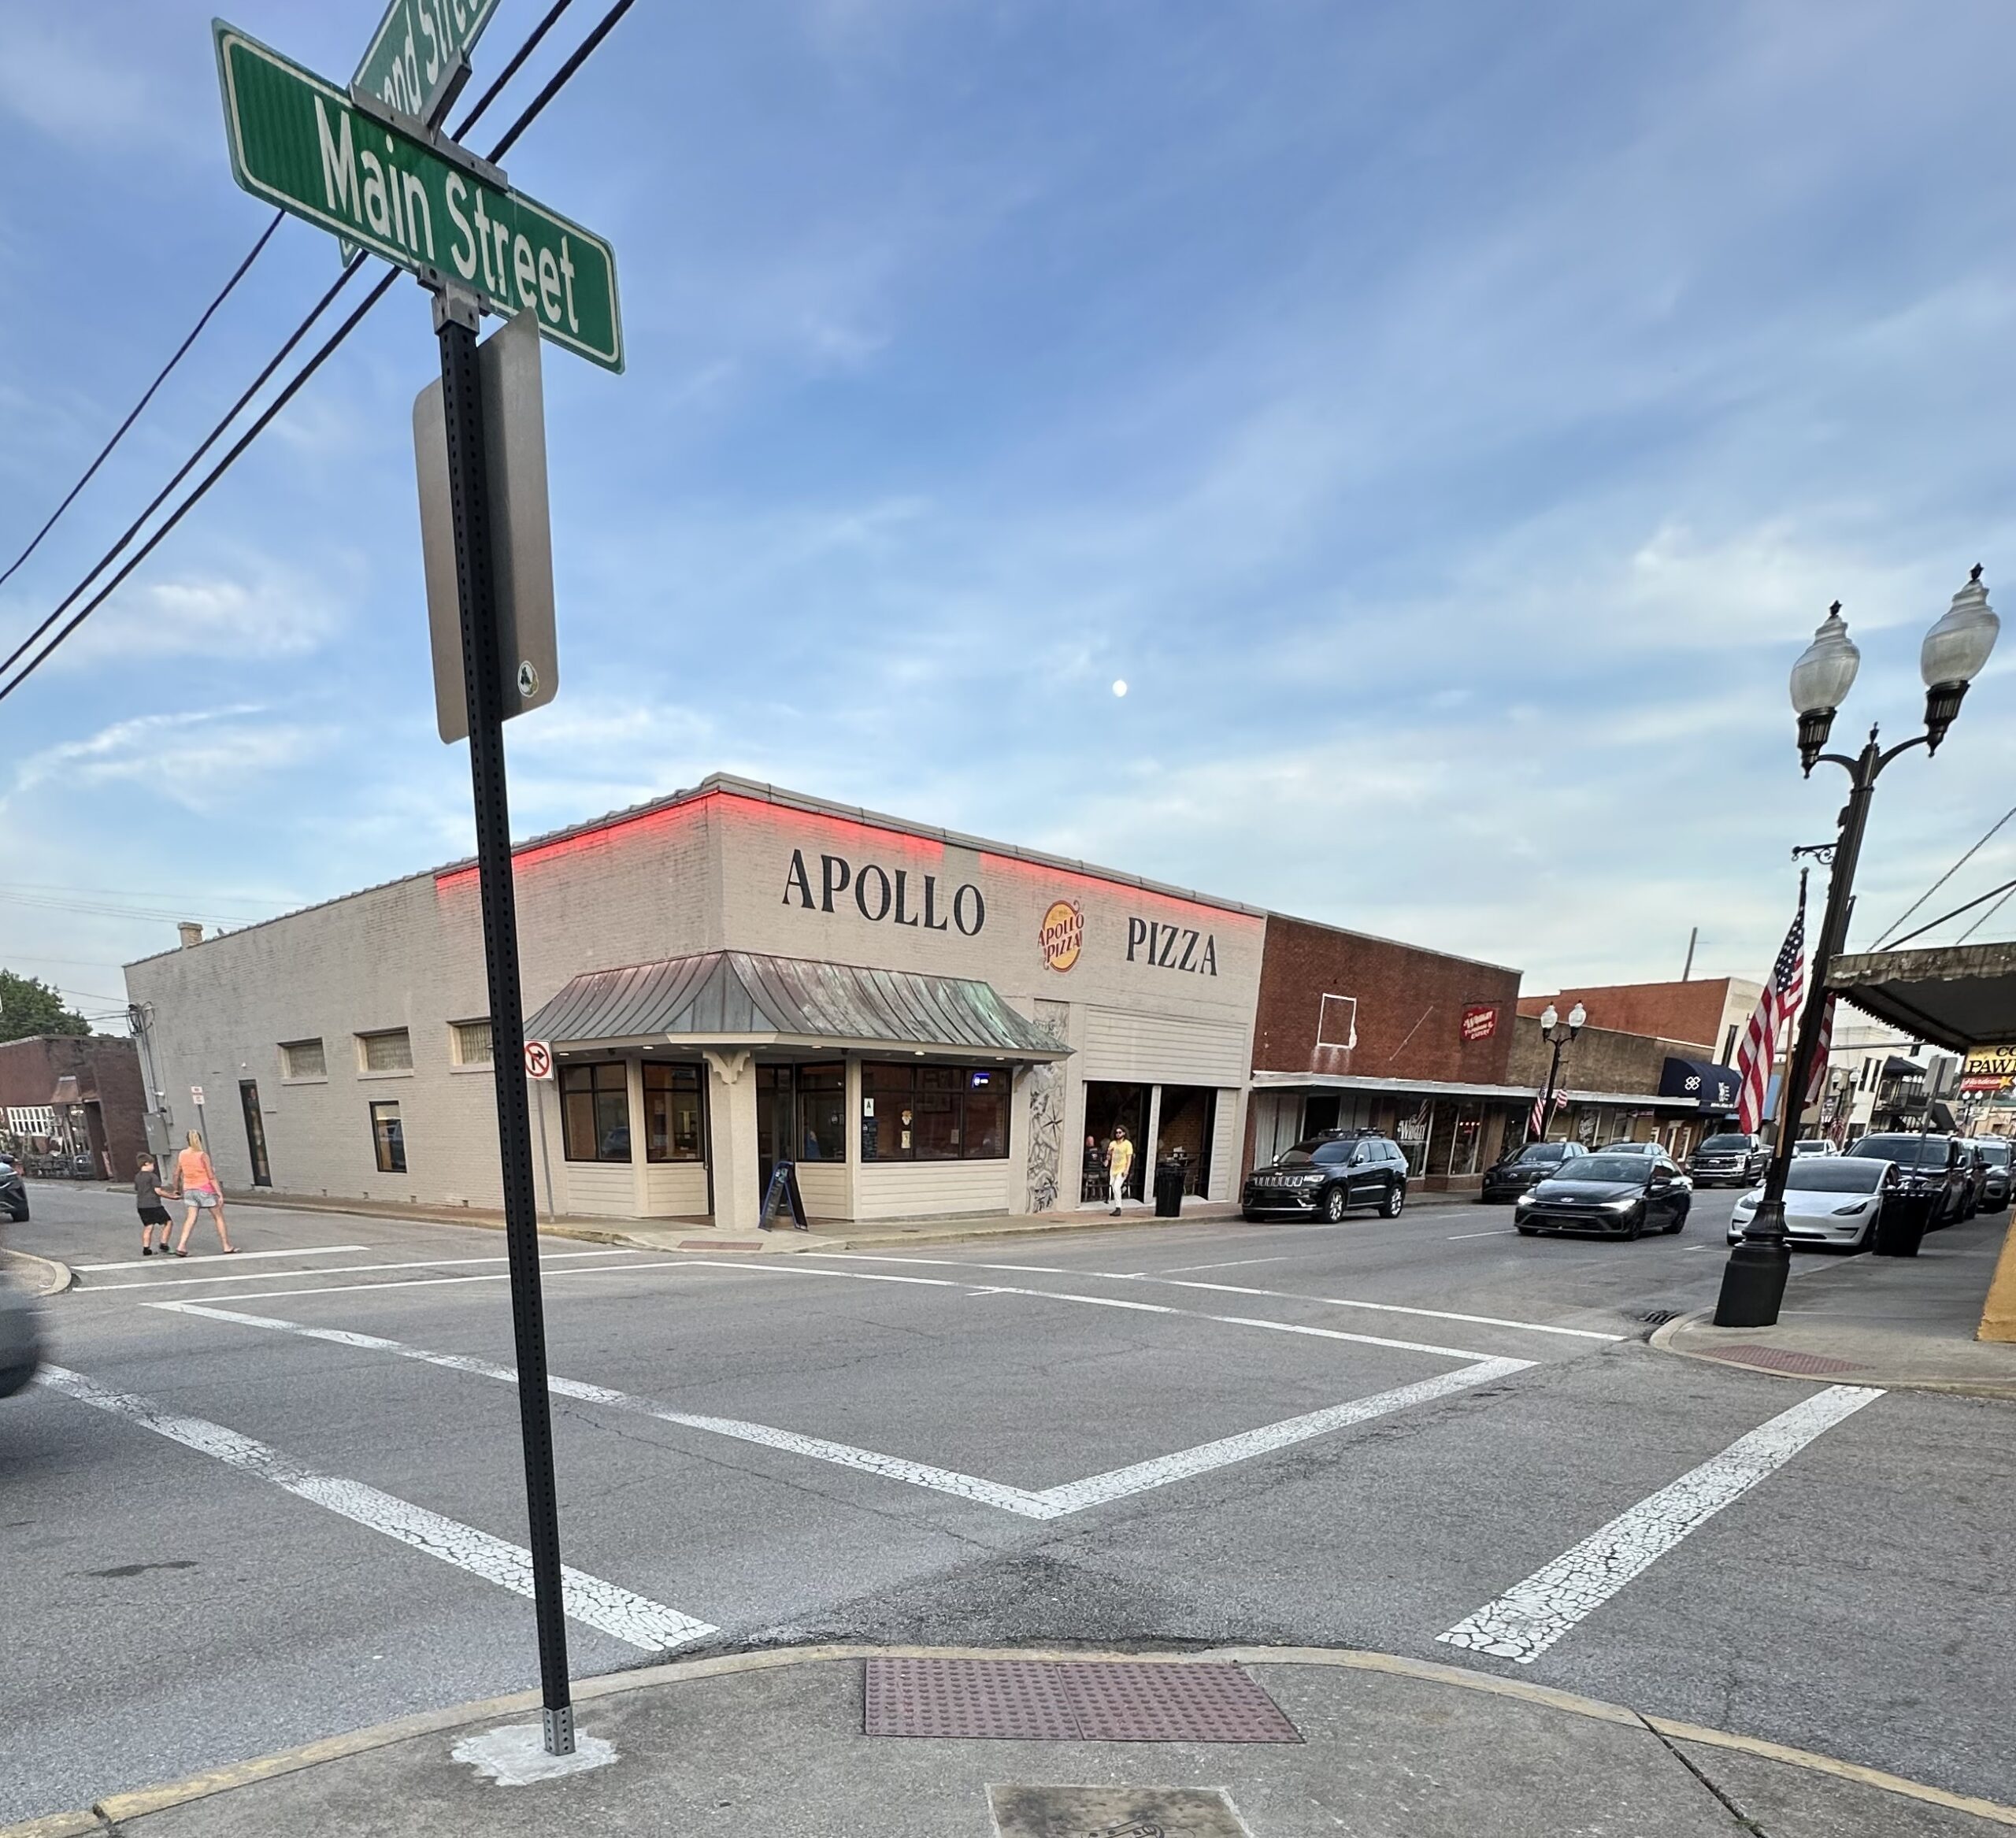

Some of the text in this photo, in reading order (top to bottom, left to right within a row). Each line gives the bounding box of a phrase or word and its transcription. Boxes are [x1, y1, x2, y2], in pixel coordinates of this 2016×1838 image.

[314, 94, 579, 333] Main Street
[782, 848, 984, 936] APOLLO
[1037, 913, 1084, 948] APOLLO
[1047, 930, 1083, 963] PIZZA
[1126, 917, 1217, 976] PIZZA
[866, 1100, 871, 1109] A
